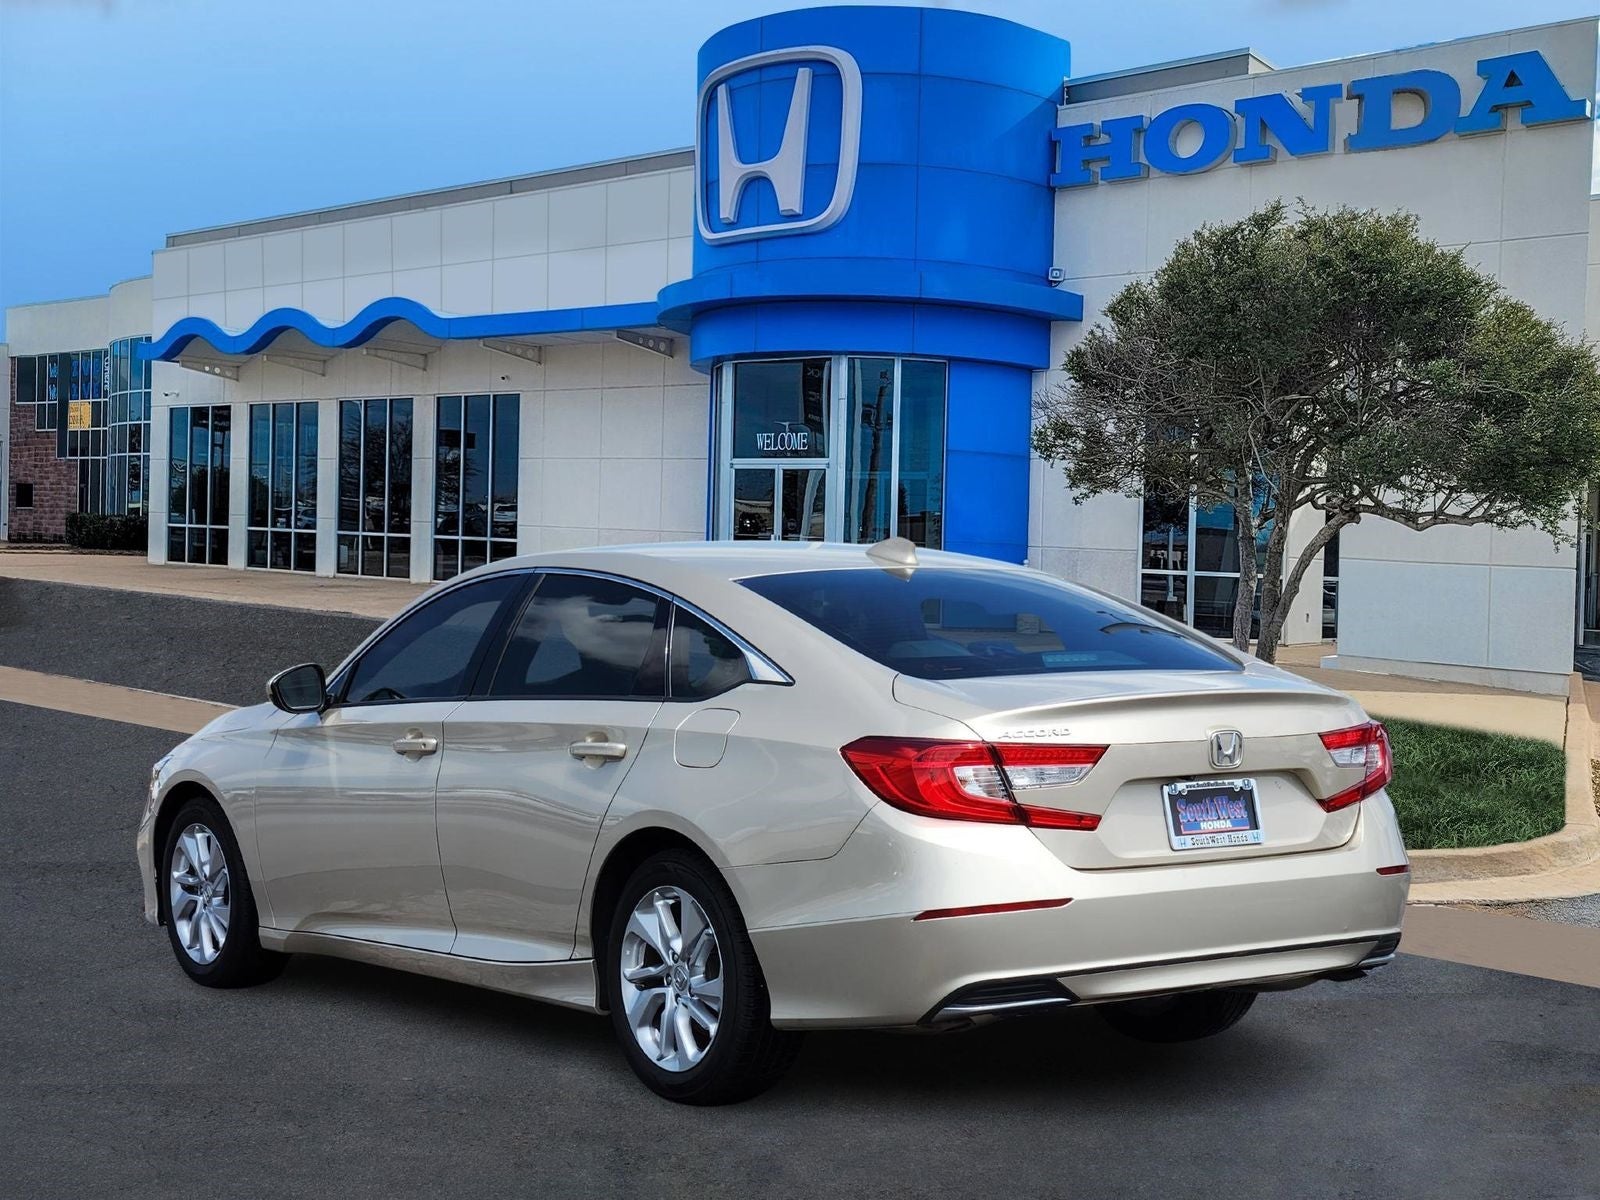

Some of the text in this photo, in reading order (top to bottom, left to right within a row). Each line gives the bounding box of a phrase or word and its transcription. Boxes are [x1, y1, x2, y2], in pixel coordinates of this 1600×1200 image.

[1050, 50, 1591, 188] HONDA
[756, 432, 808, 451] WELCOME
[998, 728, 1071, 739] ACCORD
[1200, 820, 1232, 830] HONDA
